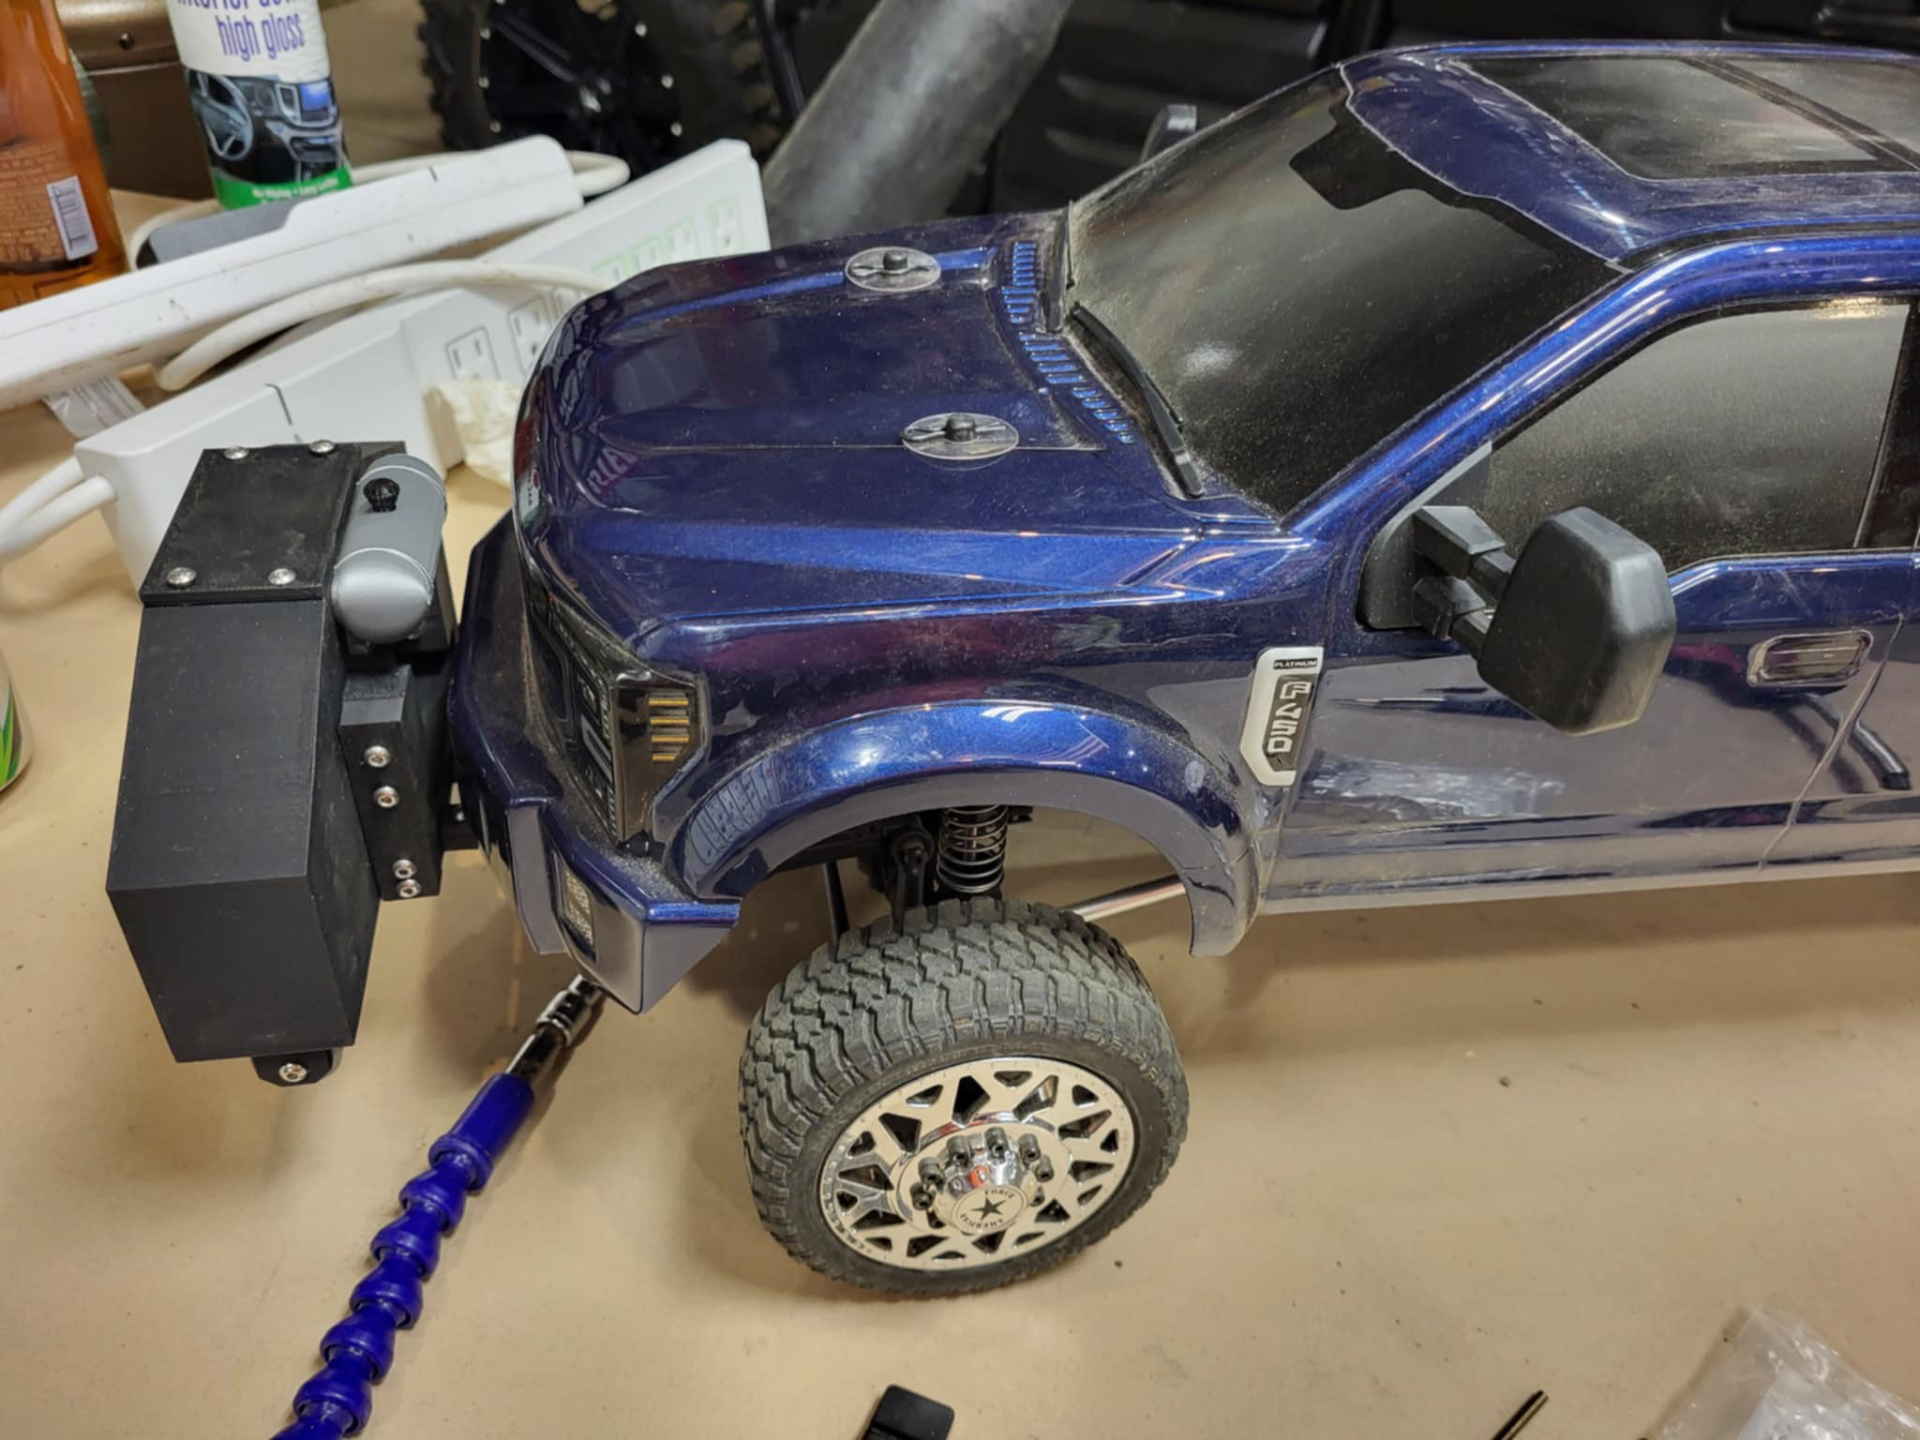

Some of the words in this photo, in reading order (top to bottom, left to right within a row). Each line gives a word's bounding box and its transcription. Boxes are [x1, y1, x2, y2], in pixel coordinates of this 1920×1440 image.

[215, 15, 260, 61] high
[261, 12, 304, 59] gloss
[1274, 659, 1318, 669] PLATINUM
